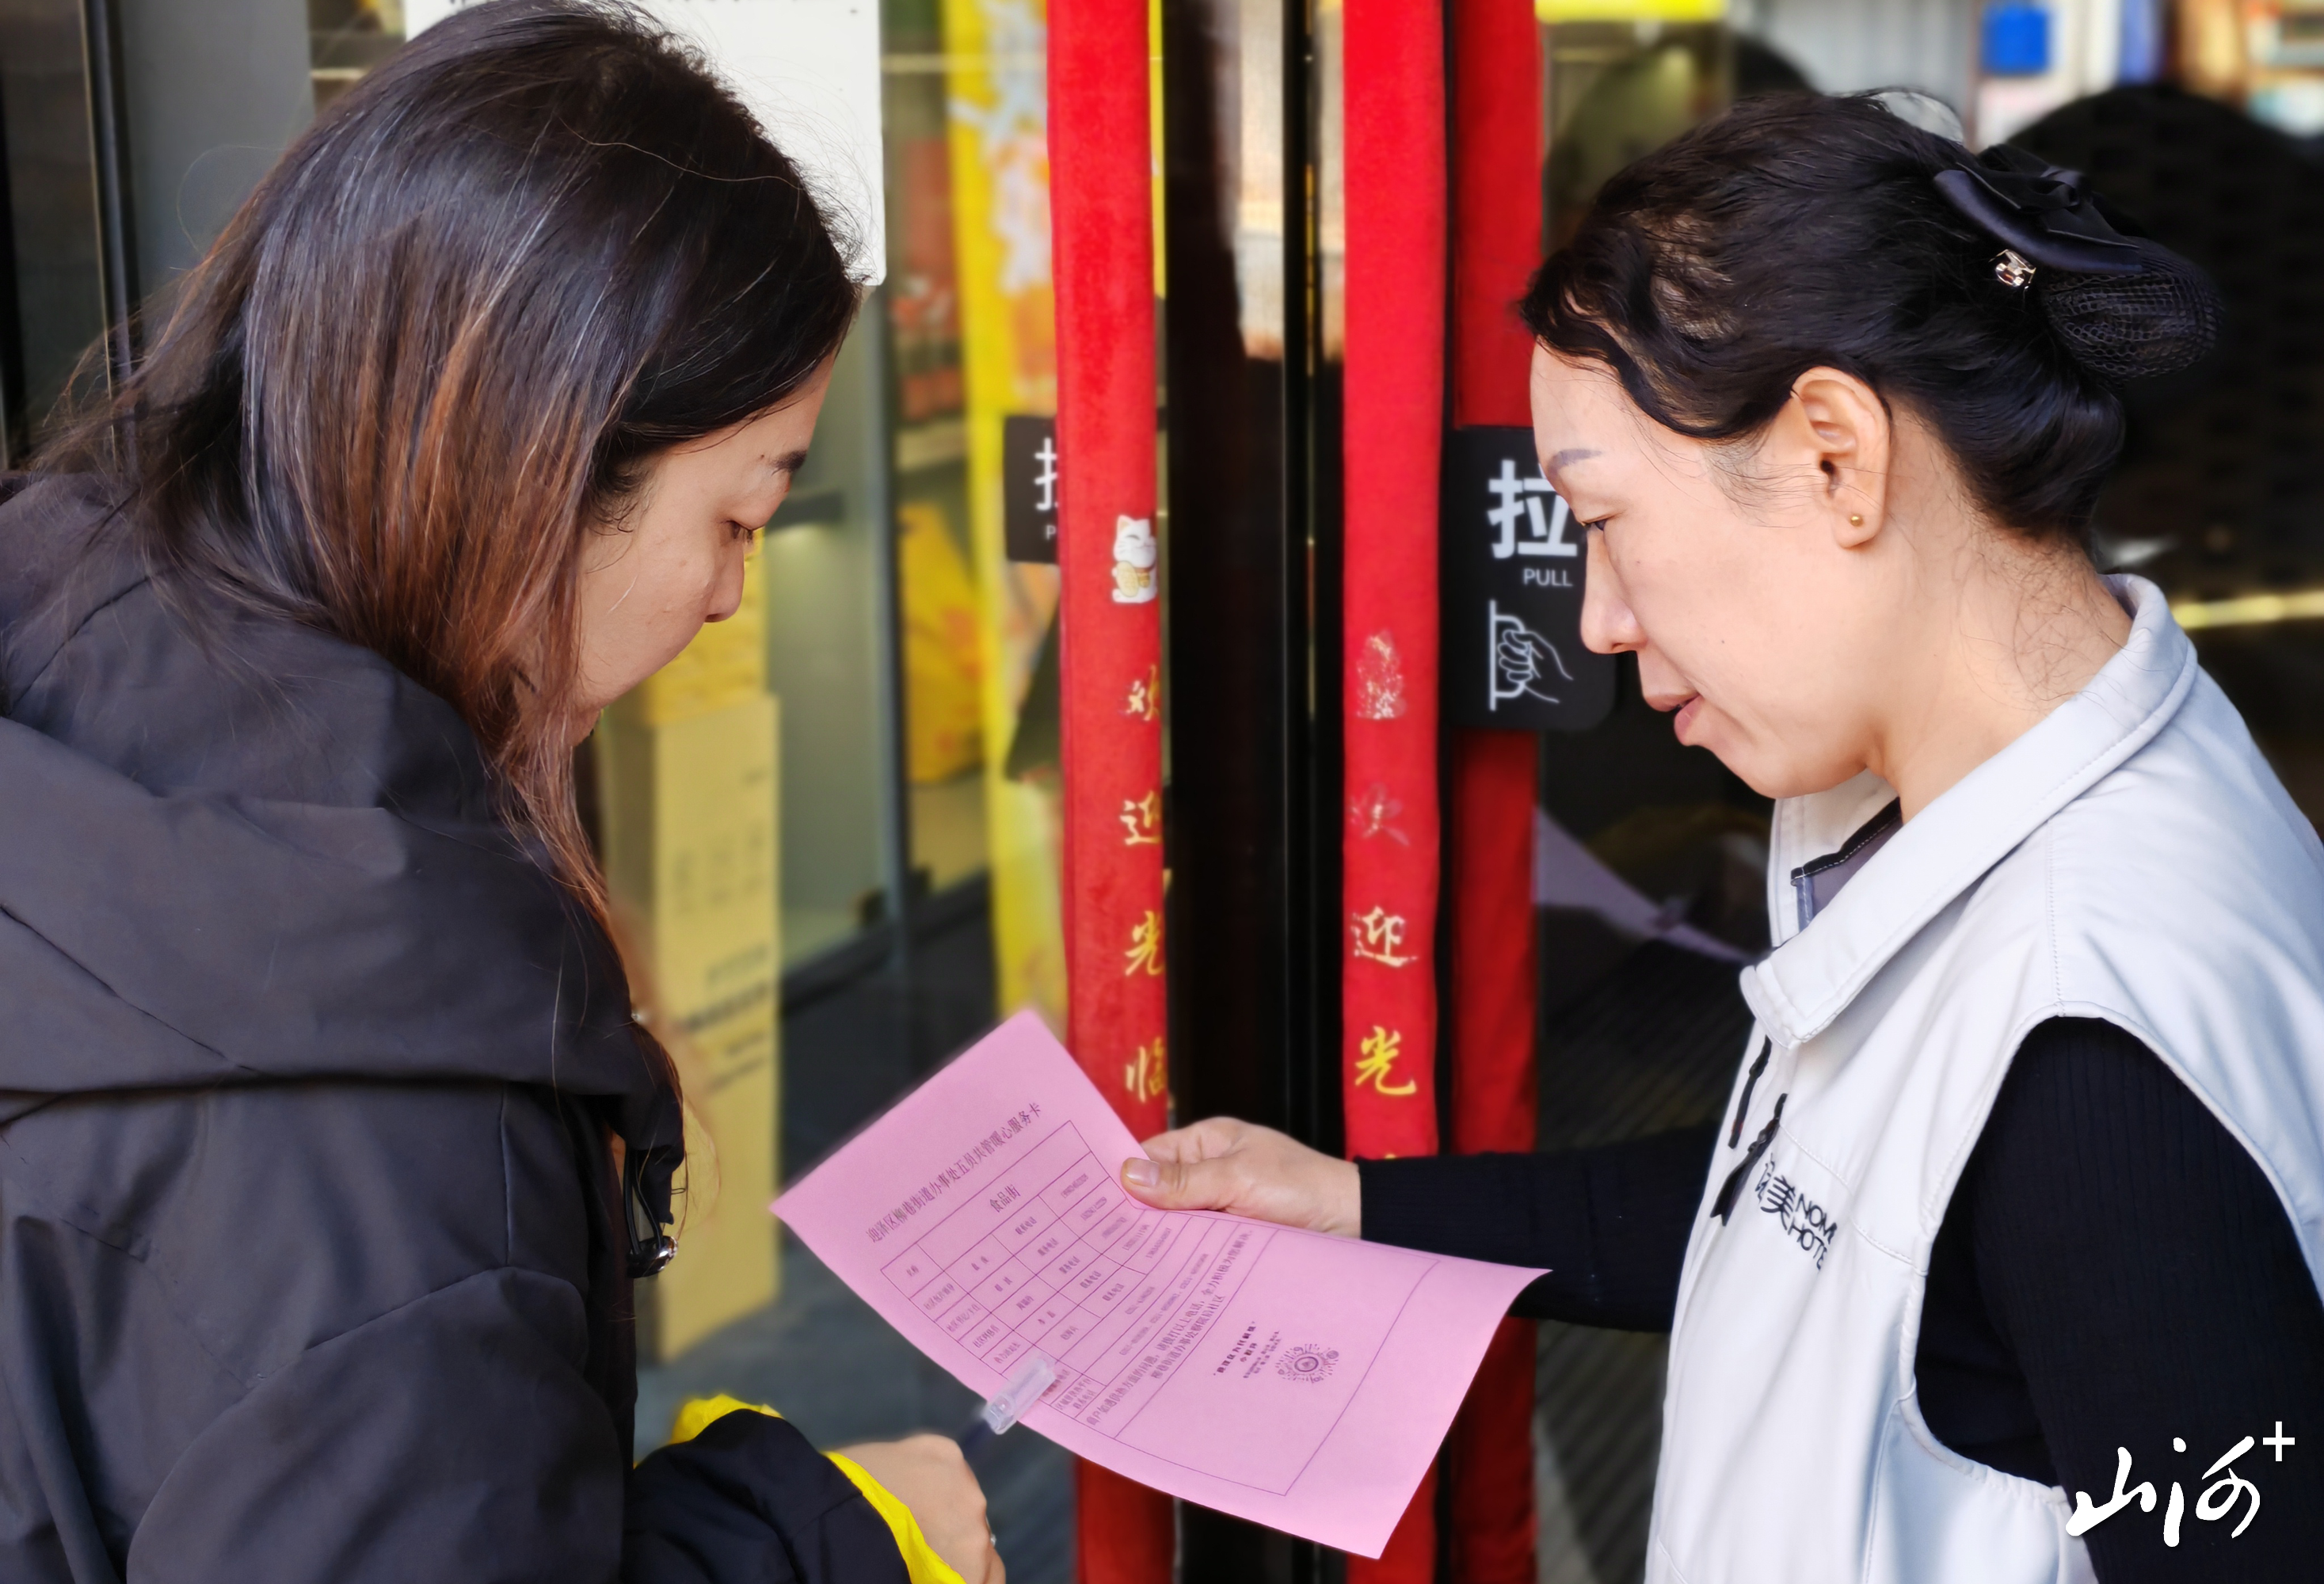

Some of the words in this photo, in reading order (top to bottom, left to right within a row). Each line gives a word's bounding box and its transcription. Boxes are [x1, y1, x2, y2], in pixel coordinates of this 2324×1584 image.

[1488, 459, 1578, 559] 拉
[1523, 568, 1573, 587] PULL
[990, 1184, 1021, 1213] 食品街
